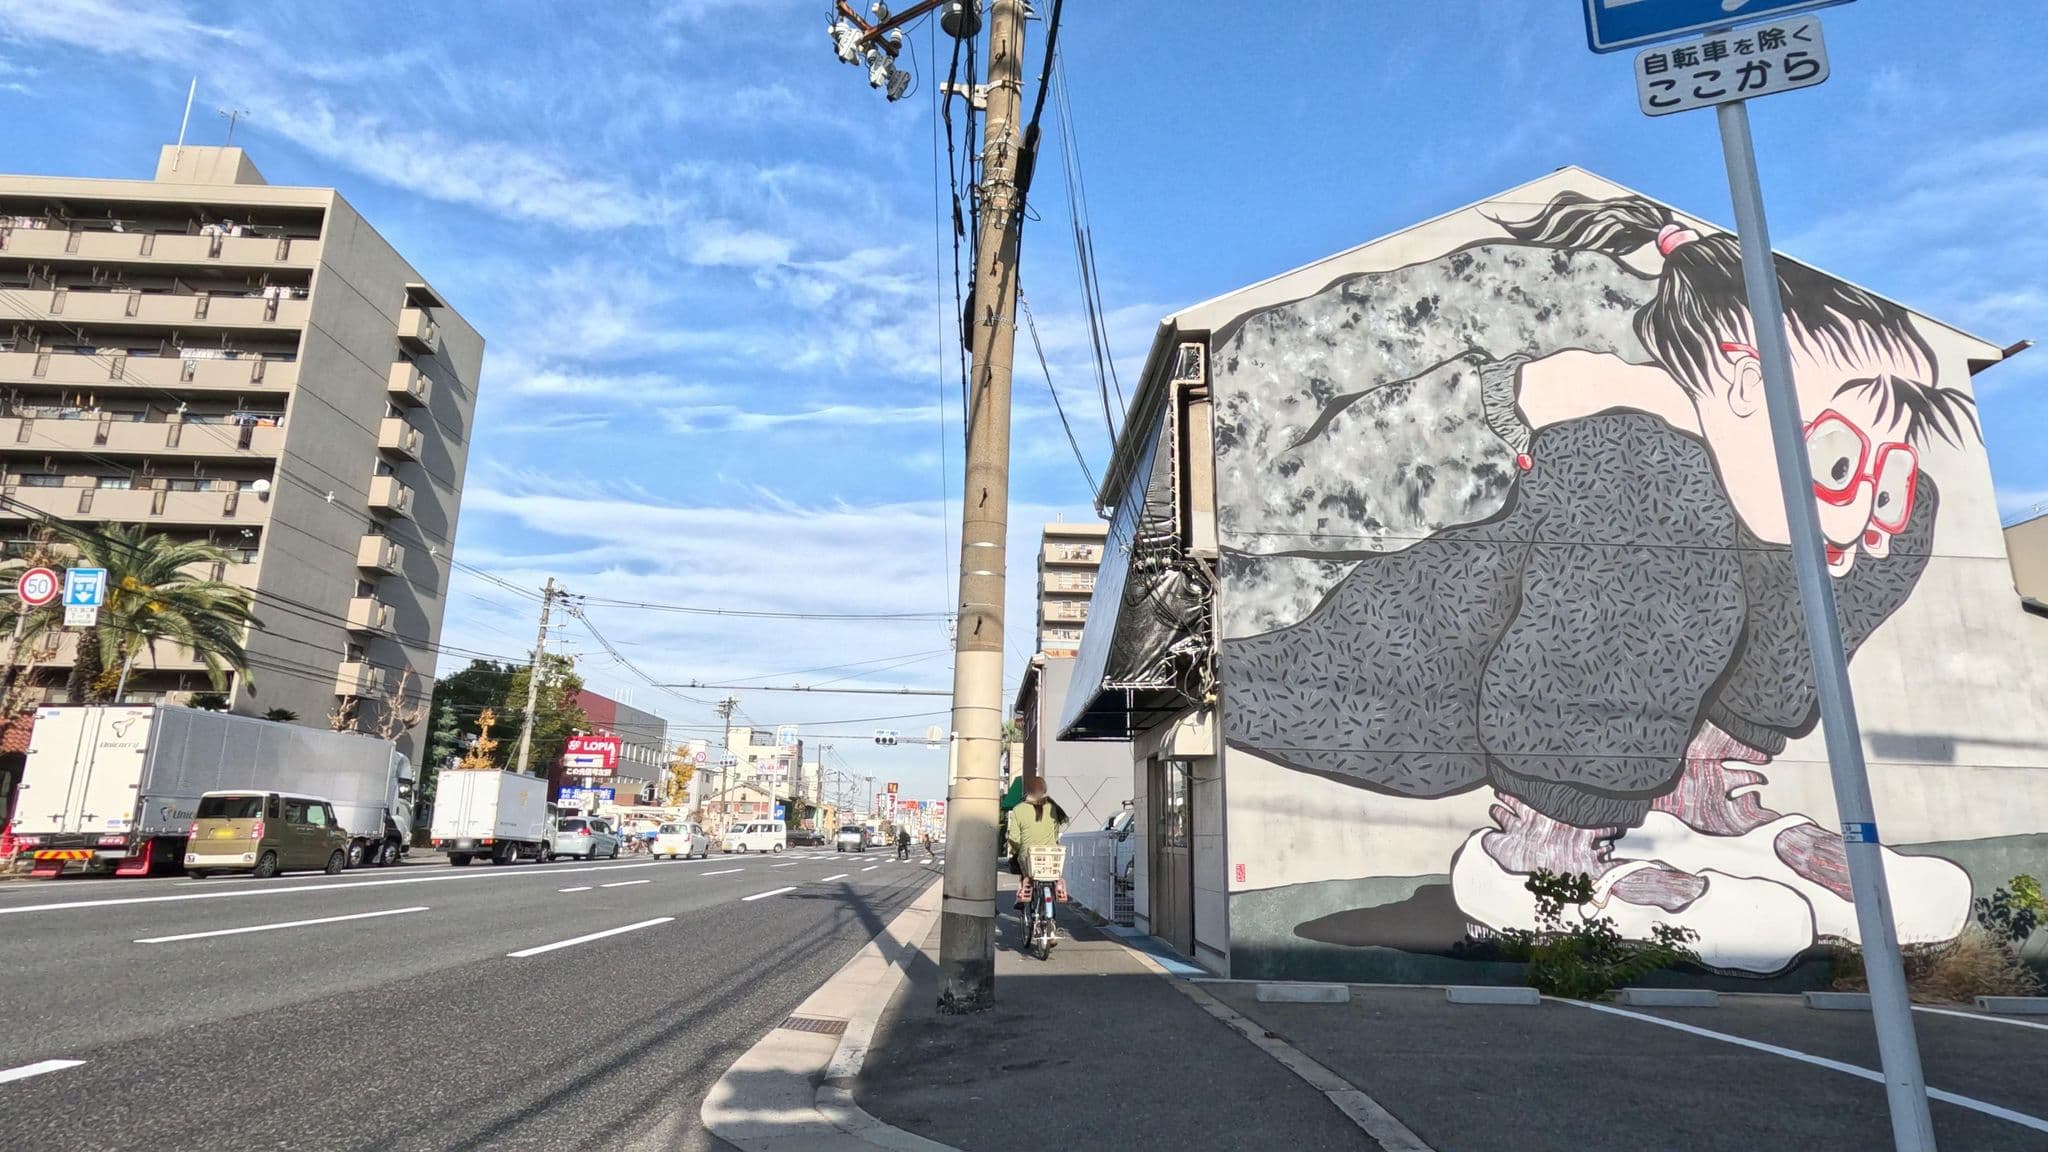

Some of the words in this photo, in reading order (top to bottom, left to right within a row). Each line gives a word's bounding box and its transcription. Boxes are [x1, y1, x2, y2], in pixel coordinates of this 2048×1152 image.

[1644, 25, 1812, 75] 自転車を除く
[1649, 52, 1820, 107] ここから
[28, 580, 48, 594] 50
[583, 741, 616, 751] LOPIA
